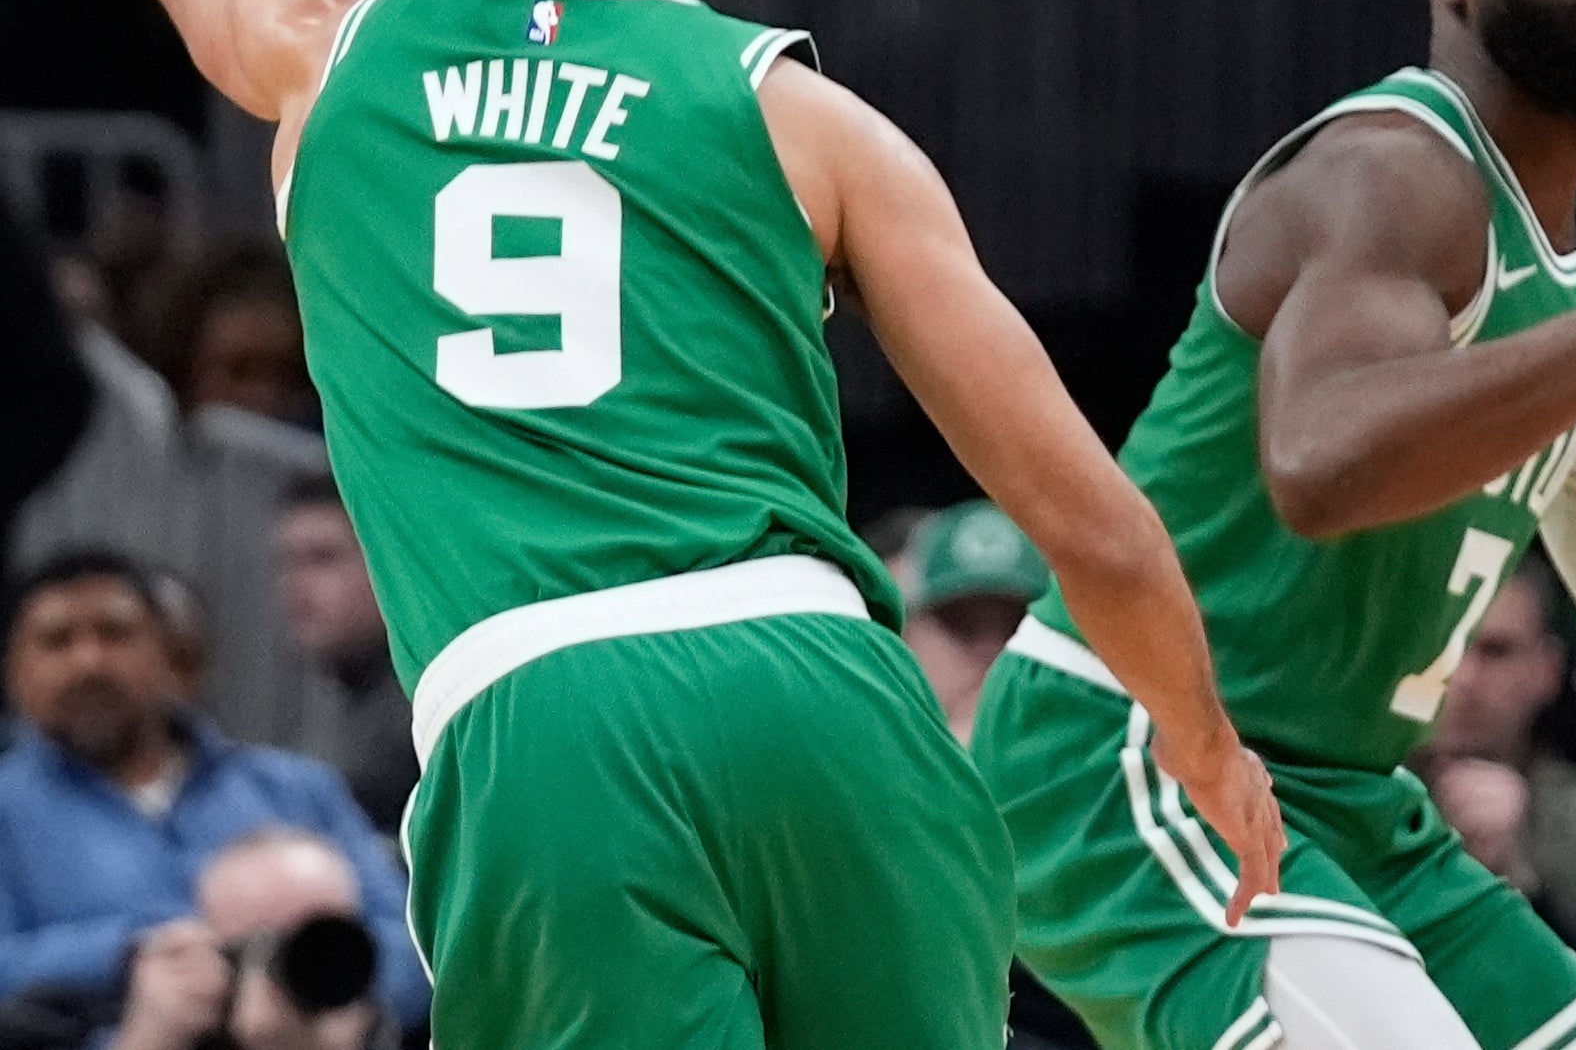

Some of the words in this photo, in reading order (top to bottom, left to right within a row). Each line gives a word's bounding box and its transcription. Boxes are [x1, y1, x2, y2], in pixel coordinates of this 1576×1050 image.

[421, 57, 651, 161] WHITE
[432, 159, 623, 409] 9
[1389, 526, 1515, 725] 7
